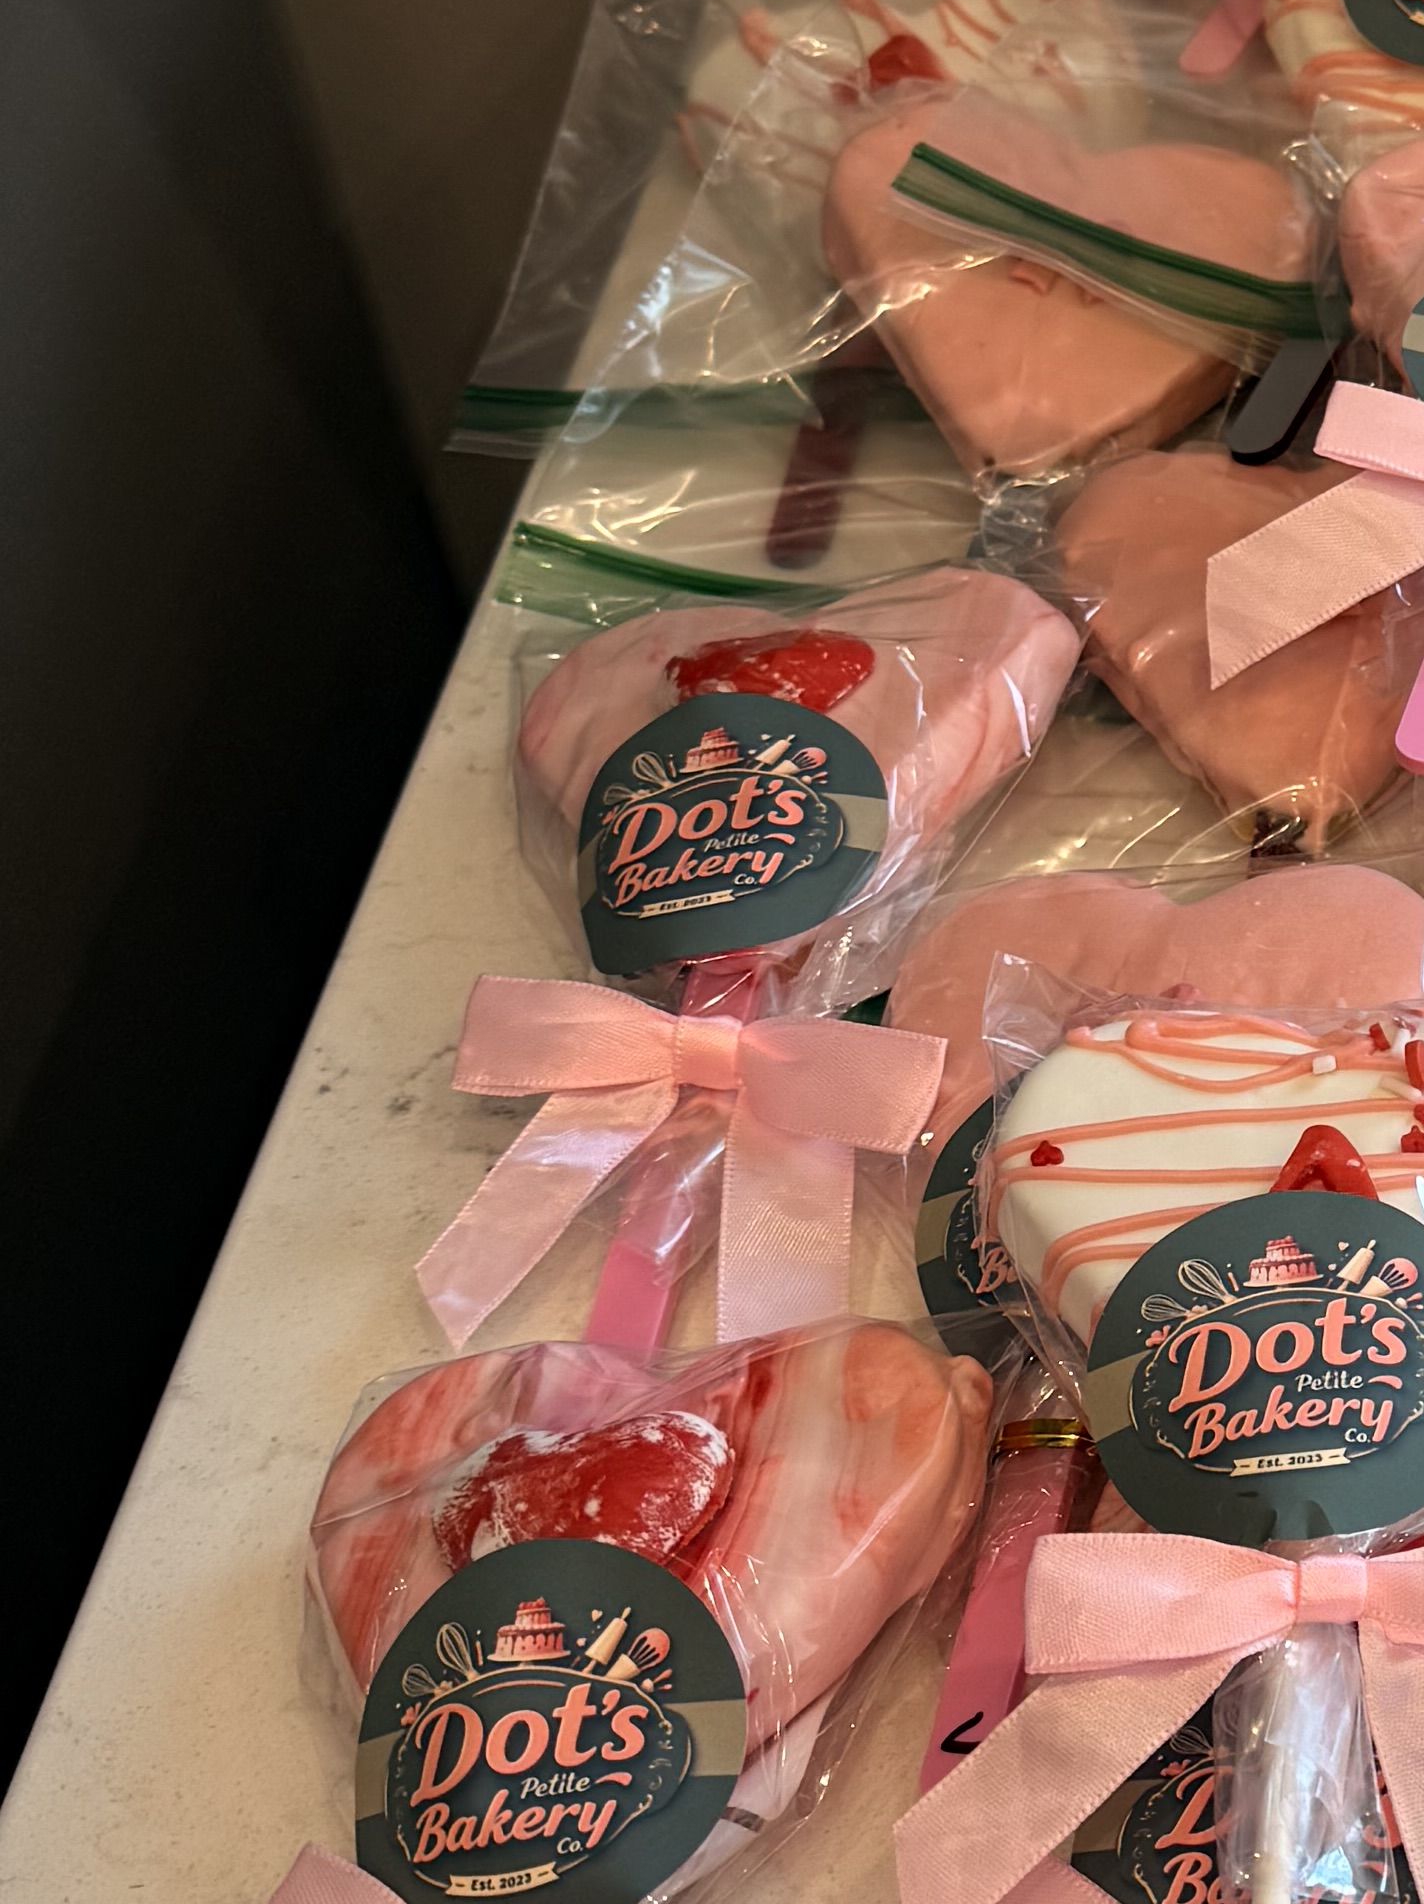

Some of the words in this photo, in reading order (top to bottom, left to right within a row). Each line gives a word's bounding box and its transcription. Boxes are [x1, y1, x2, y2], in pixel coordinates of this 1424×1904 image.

[610, 779, 807, 874] Dot's
[704, 832, 761, 853] Petite
[615, 845, 784, 906] Bakery
[735, 873, 760, 886] Co.
[1167, 1296, 1408, 1414] Dot's
[1295, 1370, 1364, 1394] Petite
[1181, 1386, 1395, 1459] Bakery
[1344, 1426, 1371, 1444] Co.
[1290, 1453, 1324, 1469] 2023
[410, 1684, 649, 1808] Dot's
[520, 1773, 591, 1799] Petite
[414, 1790, 618, 1864] Bakery
[555, 1837, 584, 1855] Co.
[499, 1873, 532, 1888] 2023
